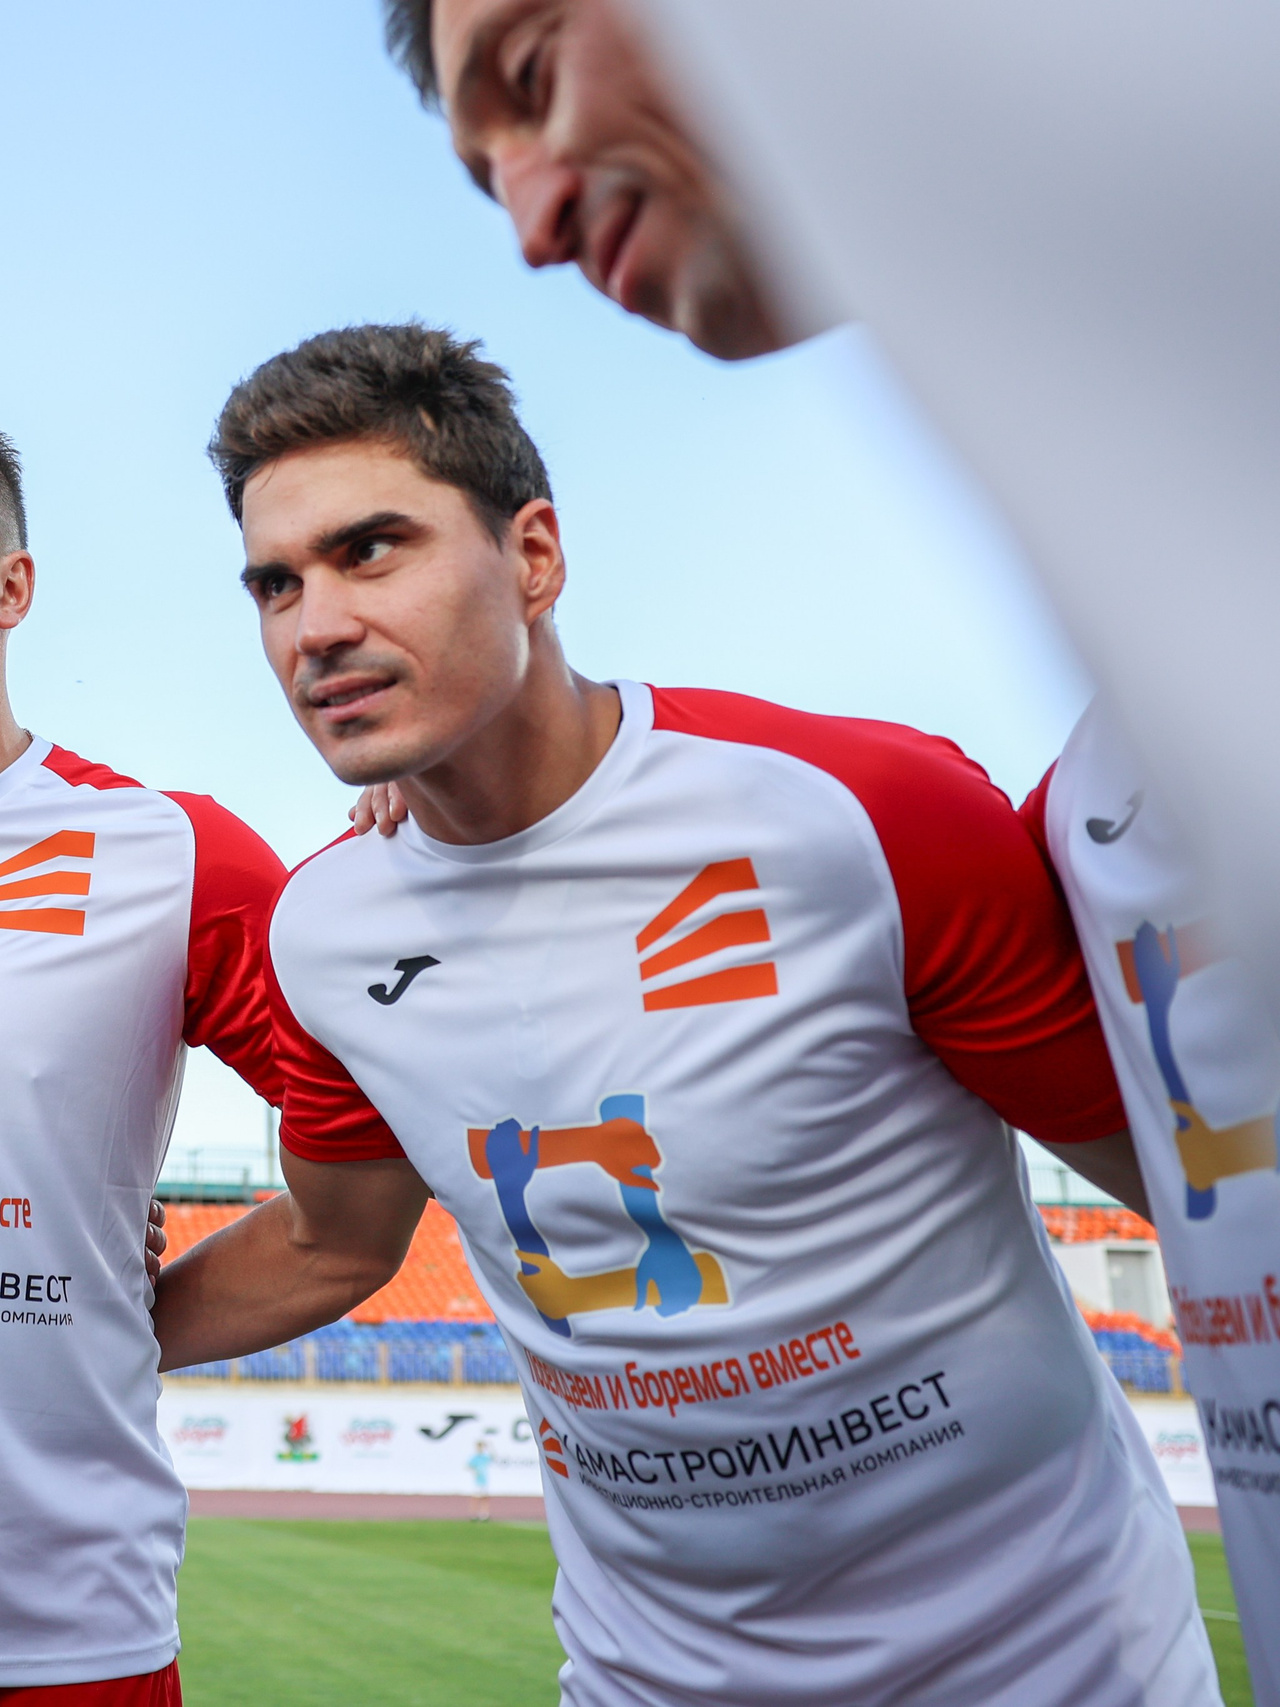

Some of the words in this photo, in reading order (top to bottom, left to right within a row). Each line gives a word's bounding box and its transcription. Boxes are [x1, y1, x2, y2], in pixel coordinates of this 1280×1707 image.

[606, 1374, 629, 1410] и
[625, 1357, 750, 1418] боремся
[748, 1321, 861, 1390] вместе
[851, 1420, 965, 1478] КОМПАНИЯ
